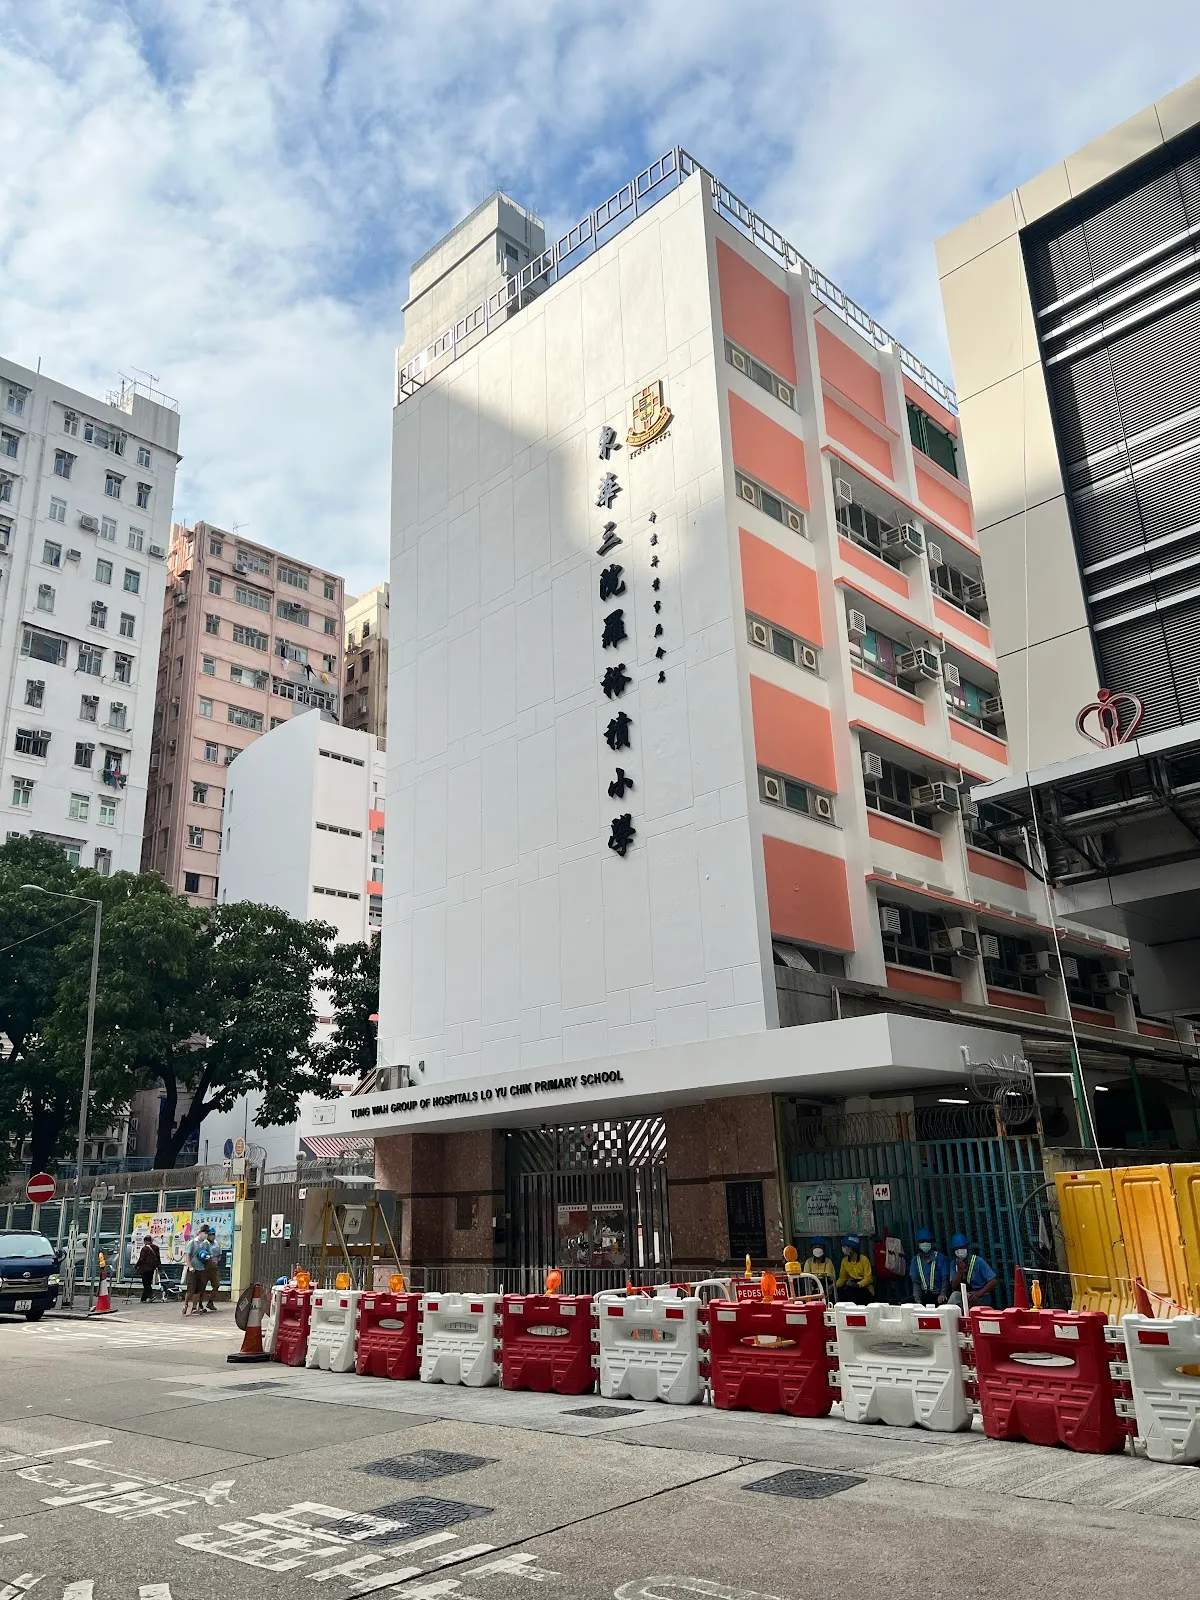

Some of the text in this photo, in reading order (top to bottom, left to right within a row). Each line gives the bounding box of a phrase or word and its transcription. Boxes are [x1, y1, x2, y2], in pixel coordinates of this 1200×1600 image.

[351, 1070, 624, 1118] TUNG WAH GROUP OF HOSPITALS LO YU CHIK PRIMARY SCHOOL
[875, 1187, 888, 1198] 4M
